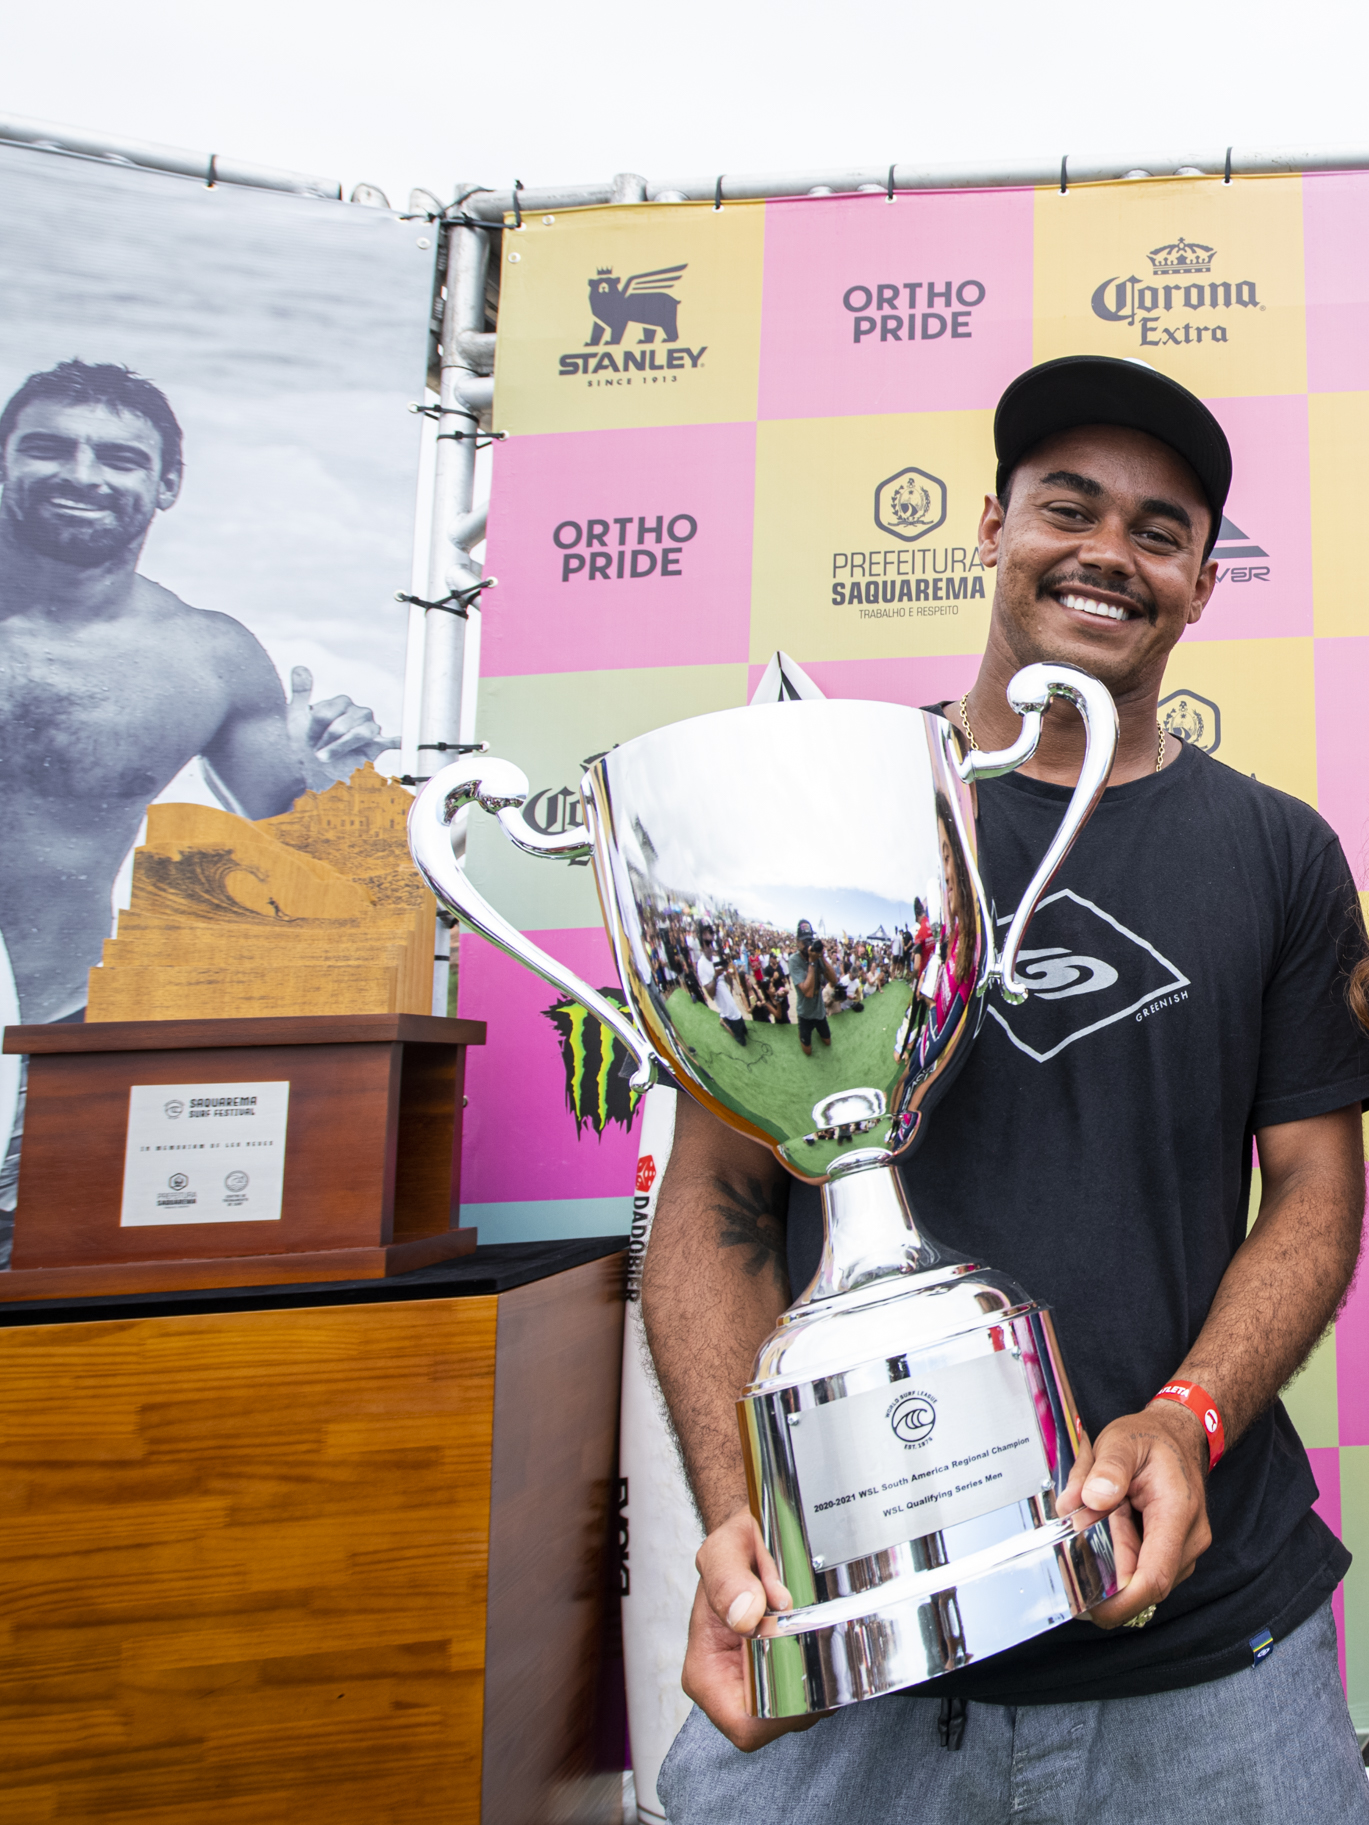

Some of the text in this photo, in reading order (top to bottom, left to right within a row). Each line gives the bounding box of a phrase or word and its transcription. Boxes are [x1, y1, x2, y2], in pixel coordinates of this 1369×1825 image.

[843, 280, 986, 313] ORTHO
[1091, 274, 1261, 327] Corona
[852, 311, 972, 344] PRIDE
[1139, 316, 1229, 347] Extra
[558, 346, 708, 376] STANLEY
[587, 375, 677, 387] SINCE 1913
[552, 513, 698, 550] ORTHO
[561, 547, 683, 582] PRIDE
[832, 547, 985, 579] PREFEITURA
[831, 576, 986, 606] SAQUAREMA
[859, 605, 959, 619] TRABALHO E RESPEITO
[1135, 990, 1189, 1022] GREENISH
[188, 1108, 255, 1118] SURF FESTIVAL
[189, 1096, 257, 1108] SAQUAREMA
[814, 1436, 1030, 1513] 2020-2021 WSL South America Regional Champion
[882, 1471, 1003, 1518] WSL Qualifying Series Men
